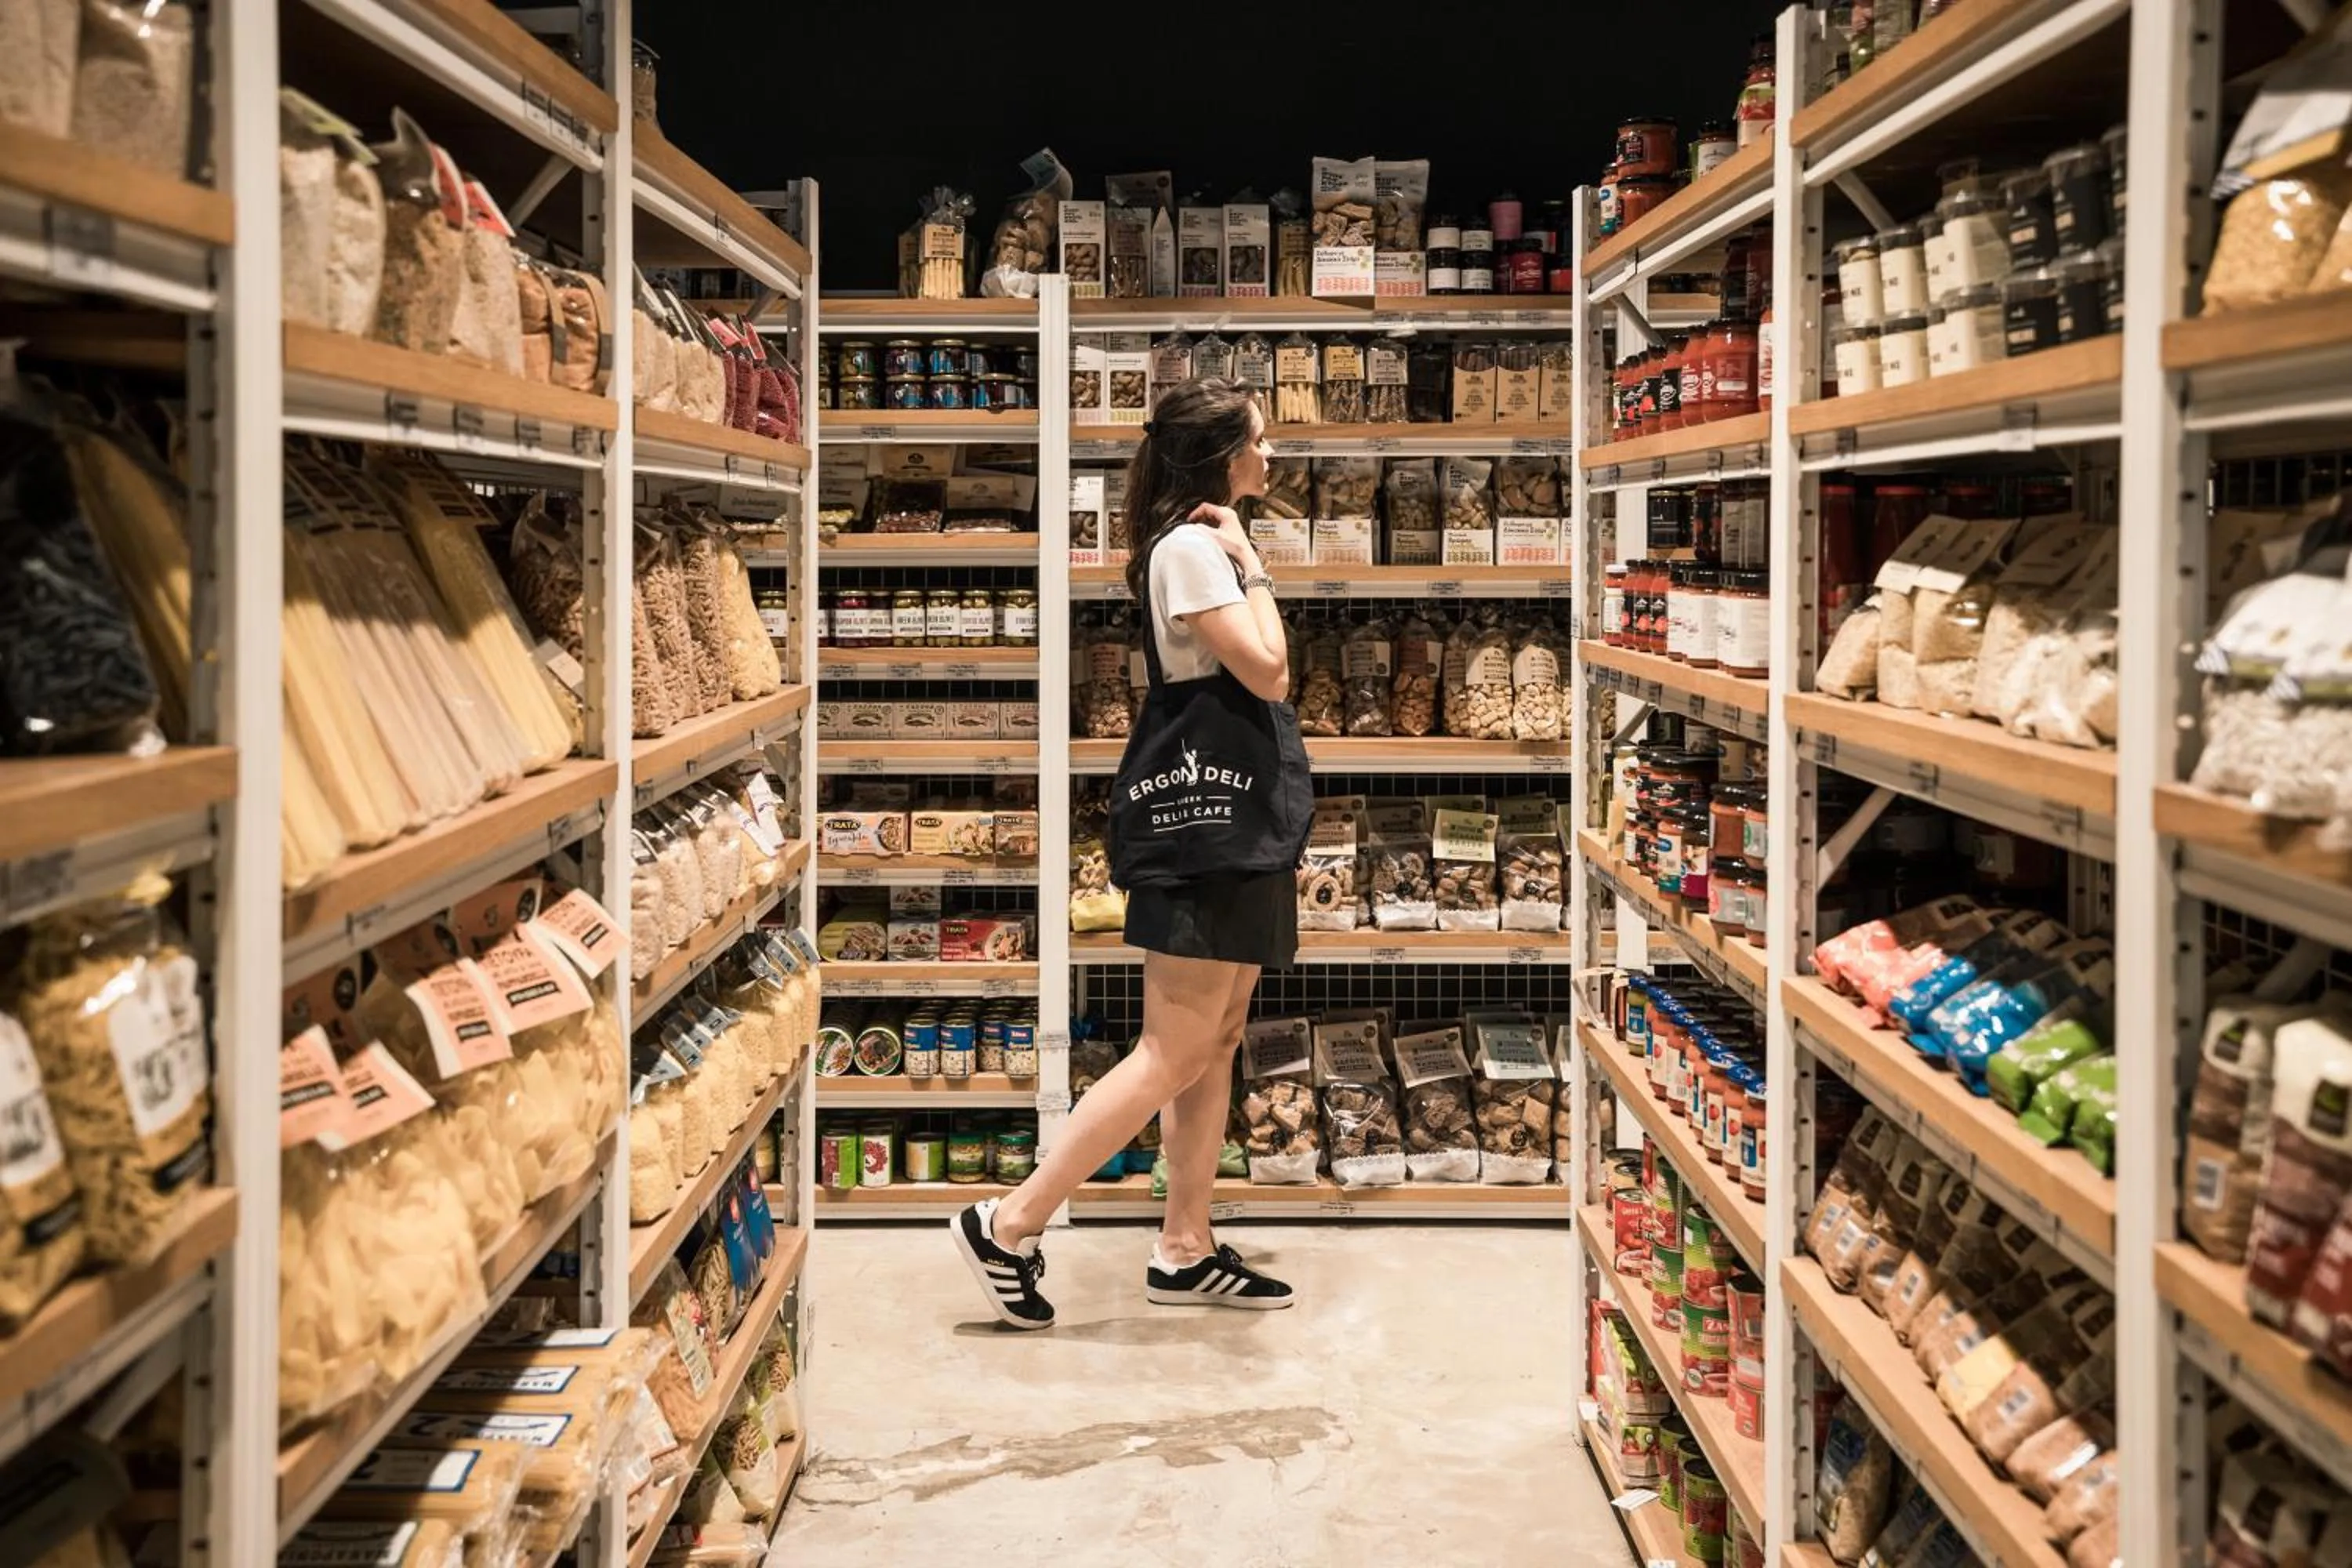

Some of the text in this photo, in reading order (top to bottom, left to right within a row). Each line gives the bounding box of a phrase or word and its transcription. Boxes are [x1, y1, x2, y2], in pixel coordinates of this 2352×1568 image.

[1128, 766, 1254, 802] ERGON DELI
[1193, 806, 1232, 817] CAFE
